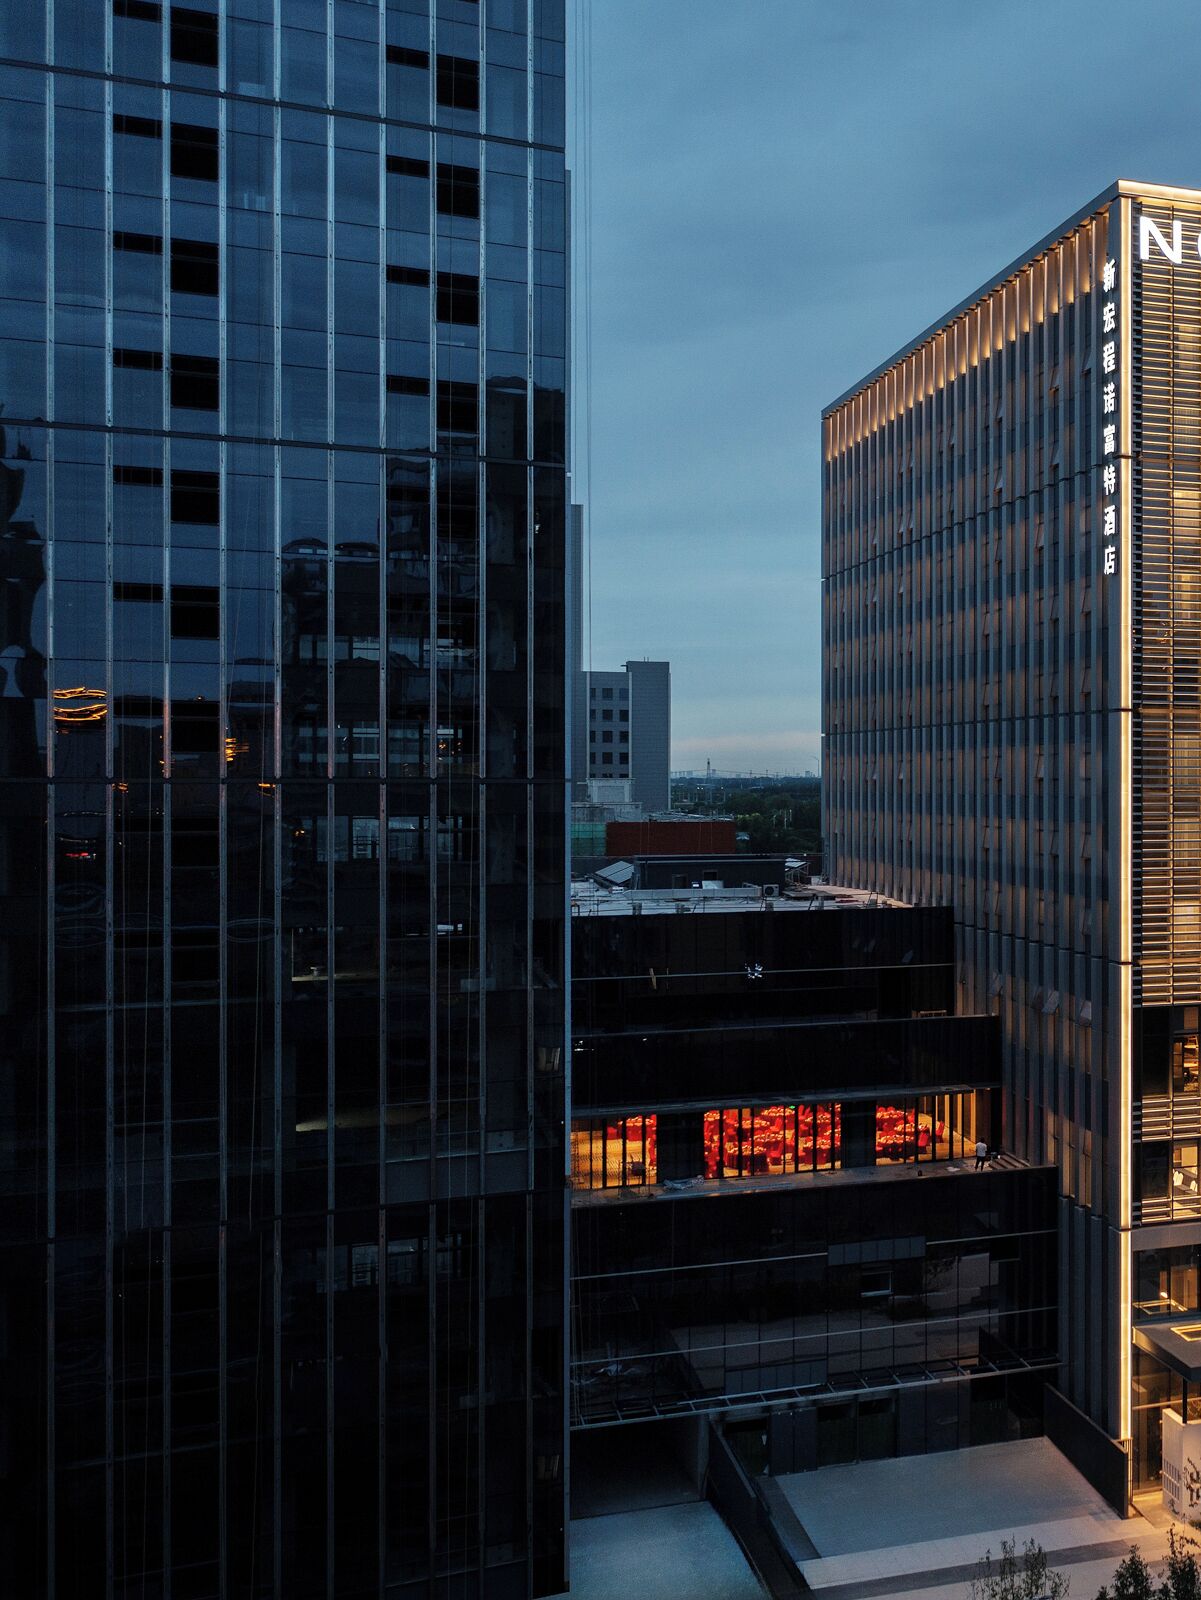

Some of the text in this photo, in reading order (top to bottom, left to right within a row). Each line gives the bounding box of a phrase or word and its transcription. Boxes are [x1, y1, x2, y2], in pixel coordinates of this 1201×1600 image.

[1102, 258, 1116, 575] 新宏程诺富特酒店
